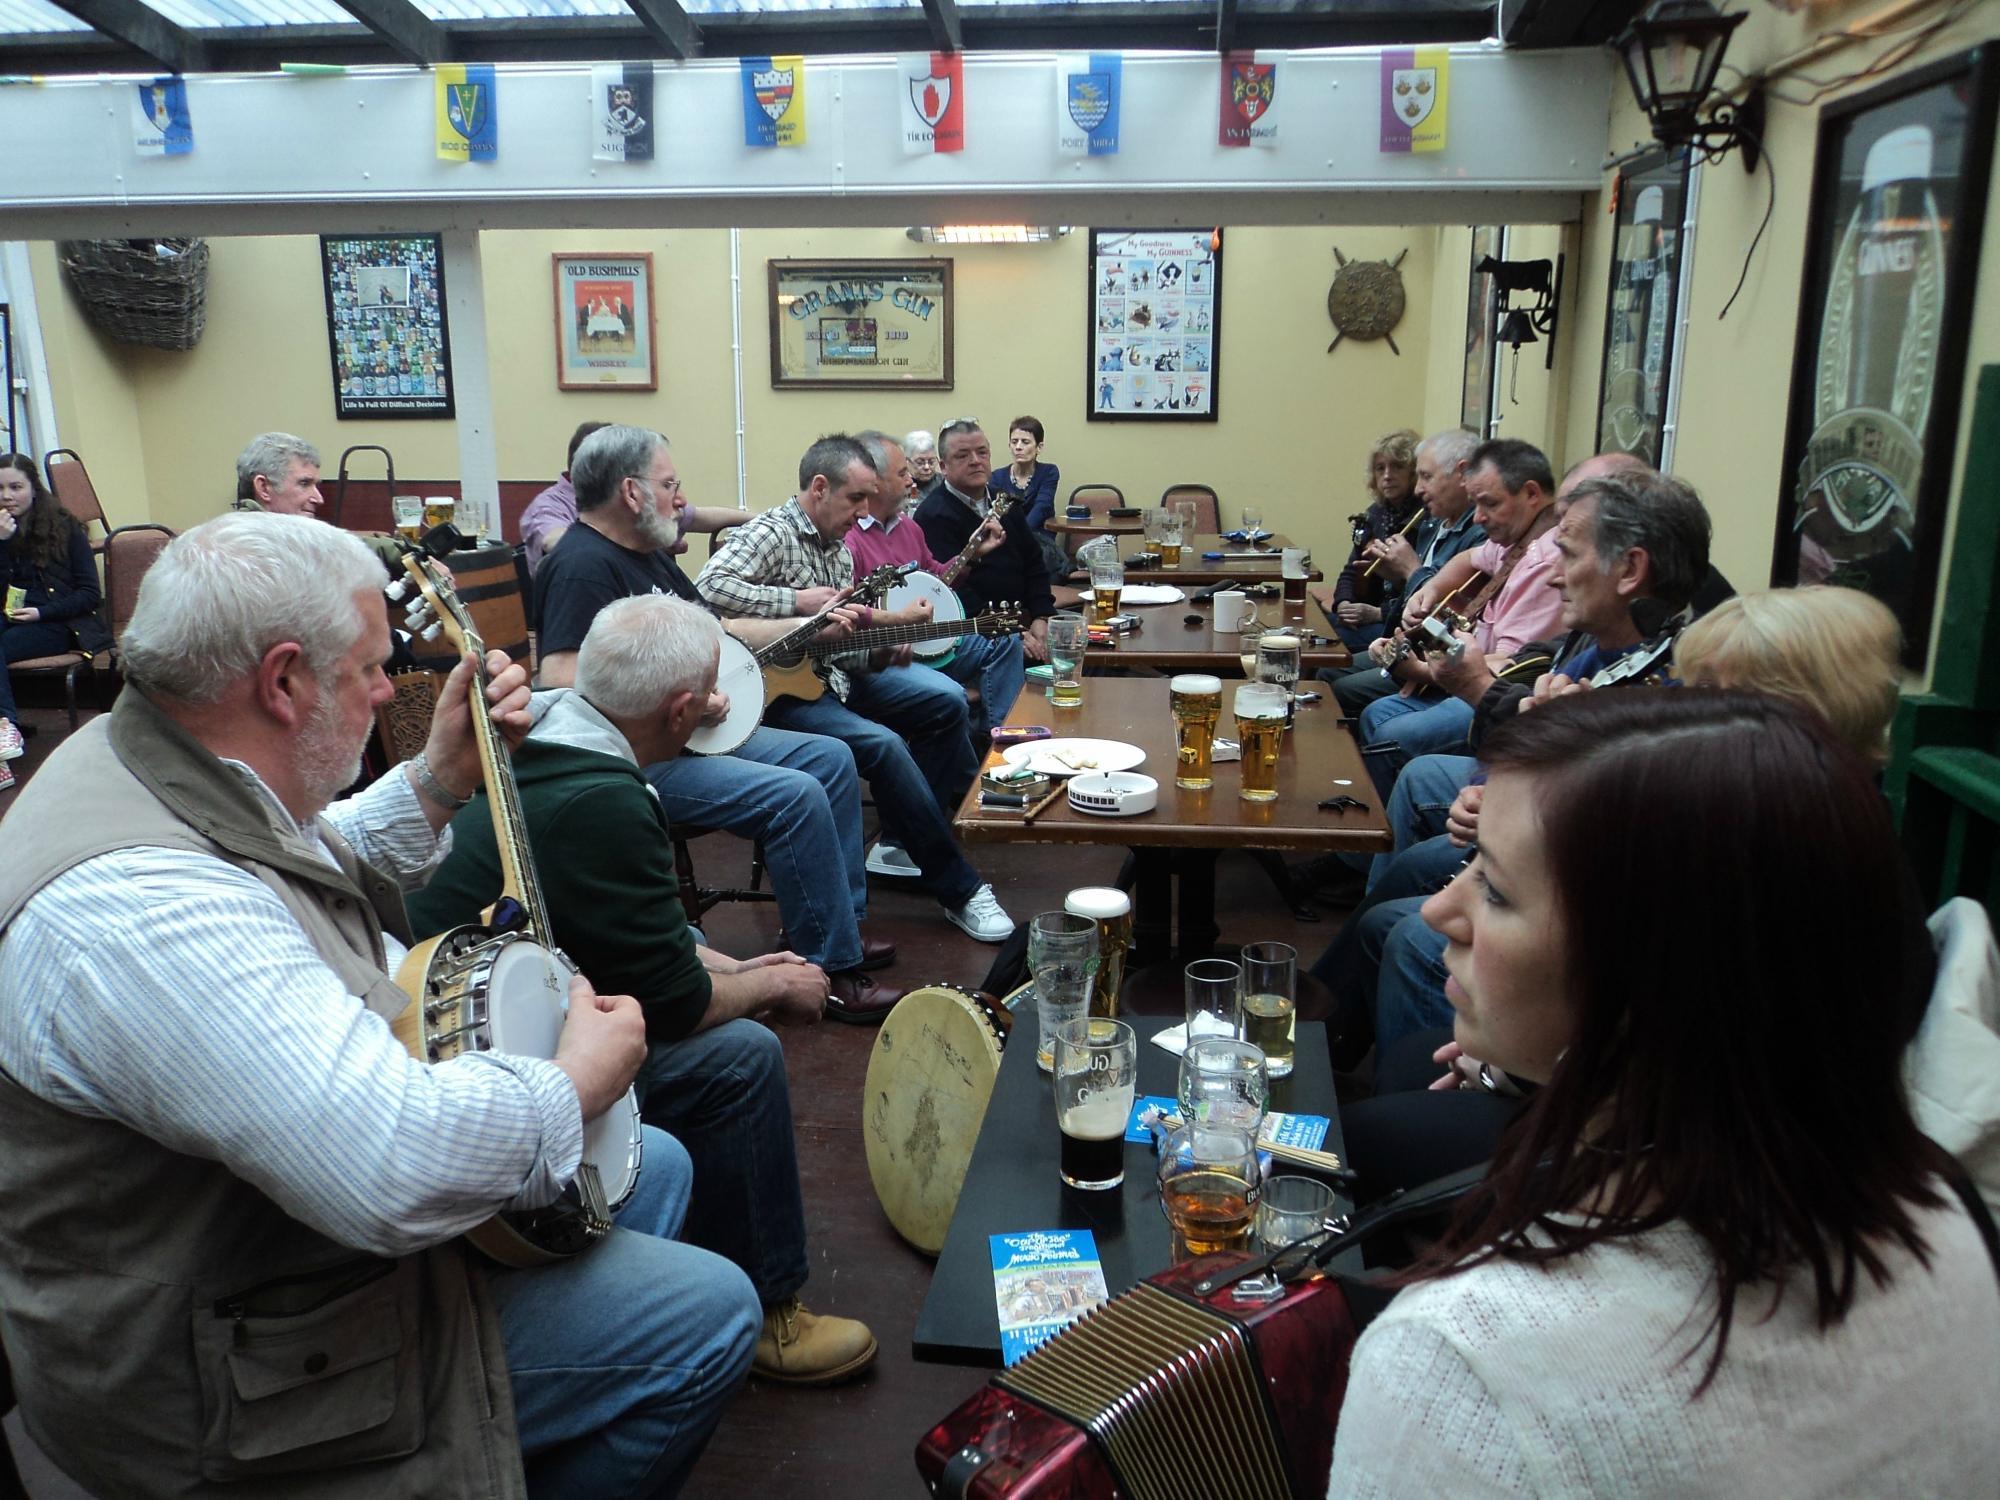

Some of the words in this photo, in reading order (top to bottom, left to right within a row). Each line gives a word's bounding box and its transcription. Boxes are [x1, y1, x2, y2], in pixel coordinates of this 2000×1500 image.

[1128, 239, 1138, 249] My
[1139, 239, 1173, 248] Goodness
[1146, 249, 1157, 259] My
[1158, 248, 1193, 256] GUINNESS
[891, 287, 934, 320] GIN
[389, 400, 415, 408] Difficult
[416, 400, 447, 408] Decisions
